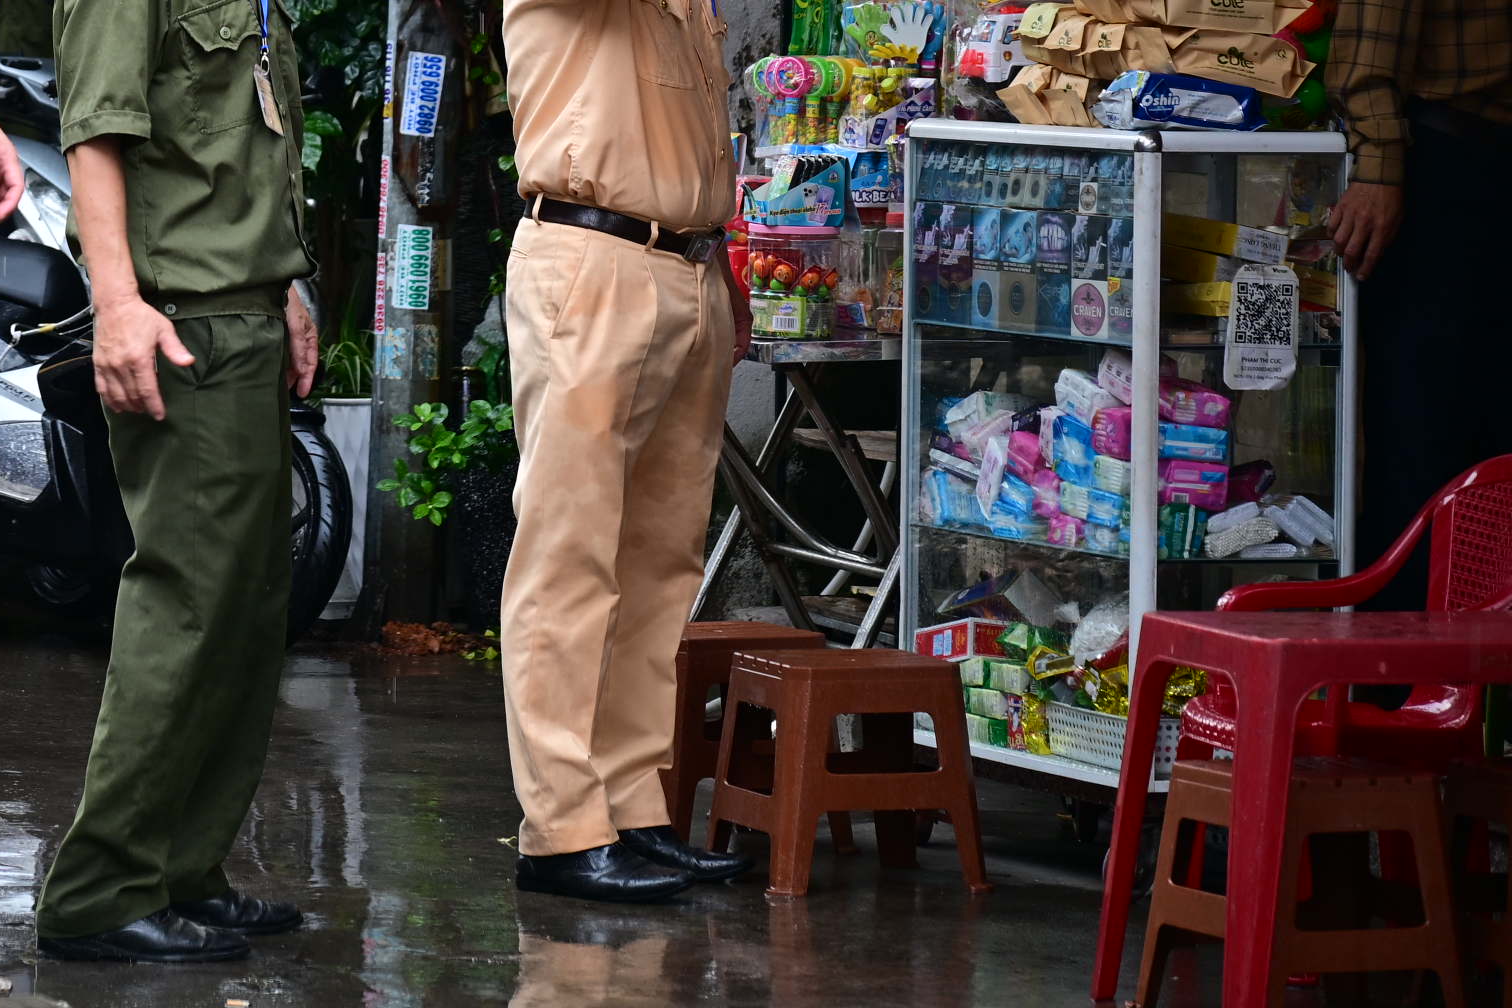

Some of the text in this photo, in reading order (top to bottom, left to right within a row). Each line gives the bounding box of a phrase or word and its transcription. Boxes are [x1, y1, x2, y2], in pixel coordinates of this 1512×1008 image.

[1217, 53, 1255, 69] cute
[416, 55, 443, 135] 0982.009.656
[1141, 93, 1181, 108] Oshin
[408, 228, 431, 309] 0961.099.008
[1073, 304, 1102, 318] CRAVEN
